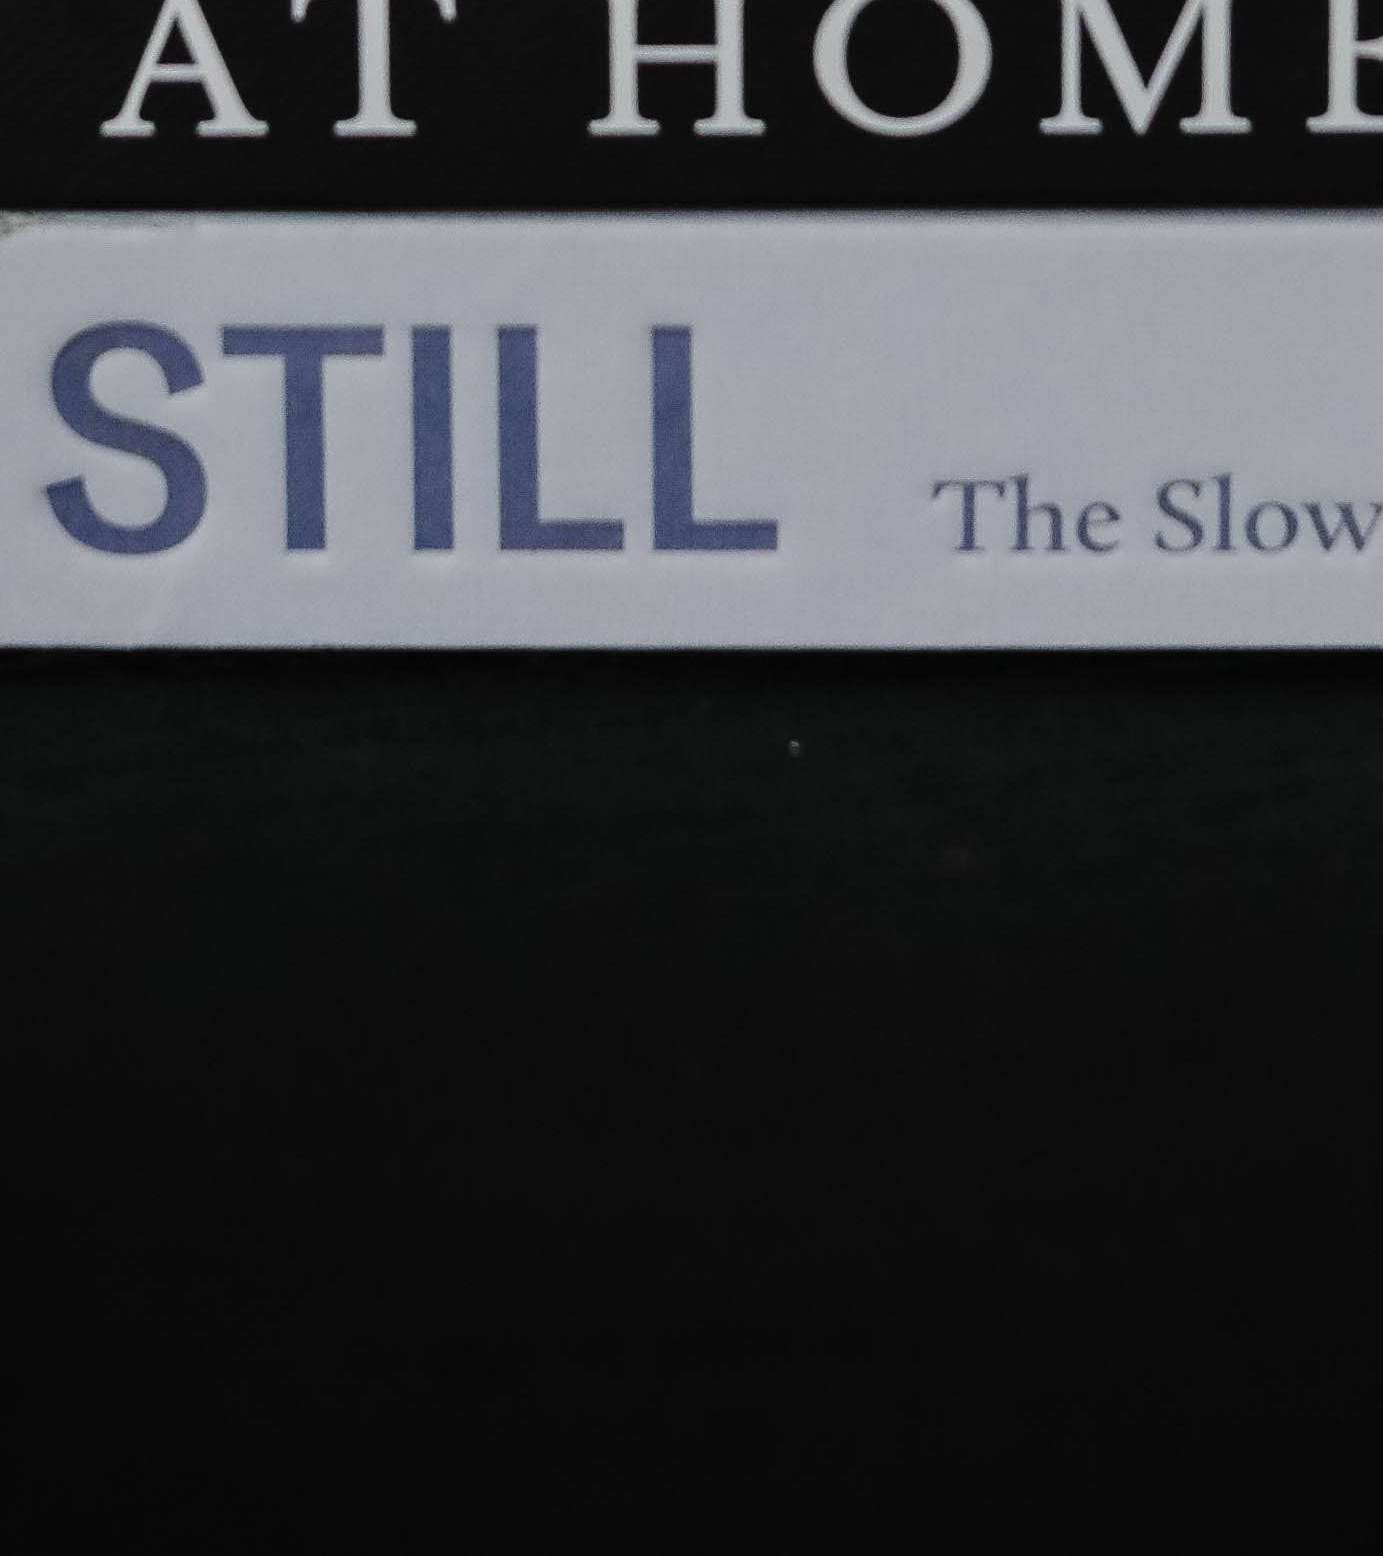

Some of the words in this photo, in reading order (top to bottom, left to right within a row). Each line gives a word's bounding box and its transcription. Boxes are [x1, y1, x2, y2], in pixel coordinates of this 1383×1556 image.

[40, 320, 778, 556] STILL
[932, 474, 1121, 553] The
[1155, 473, 1383, 552] Slow
